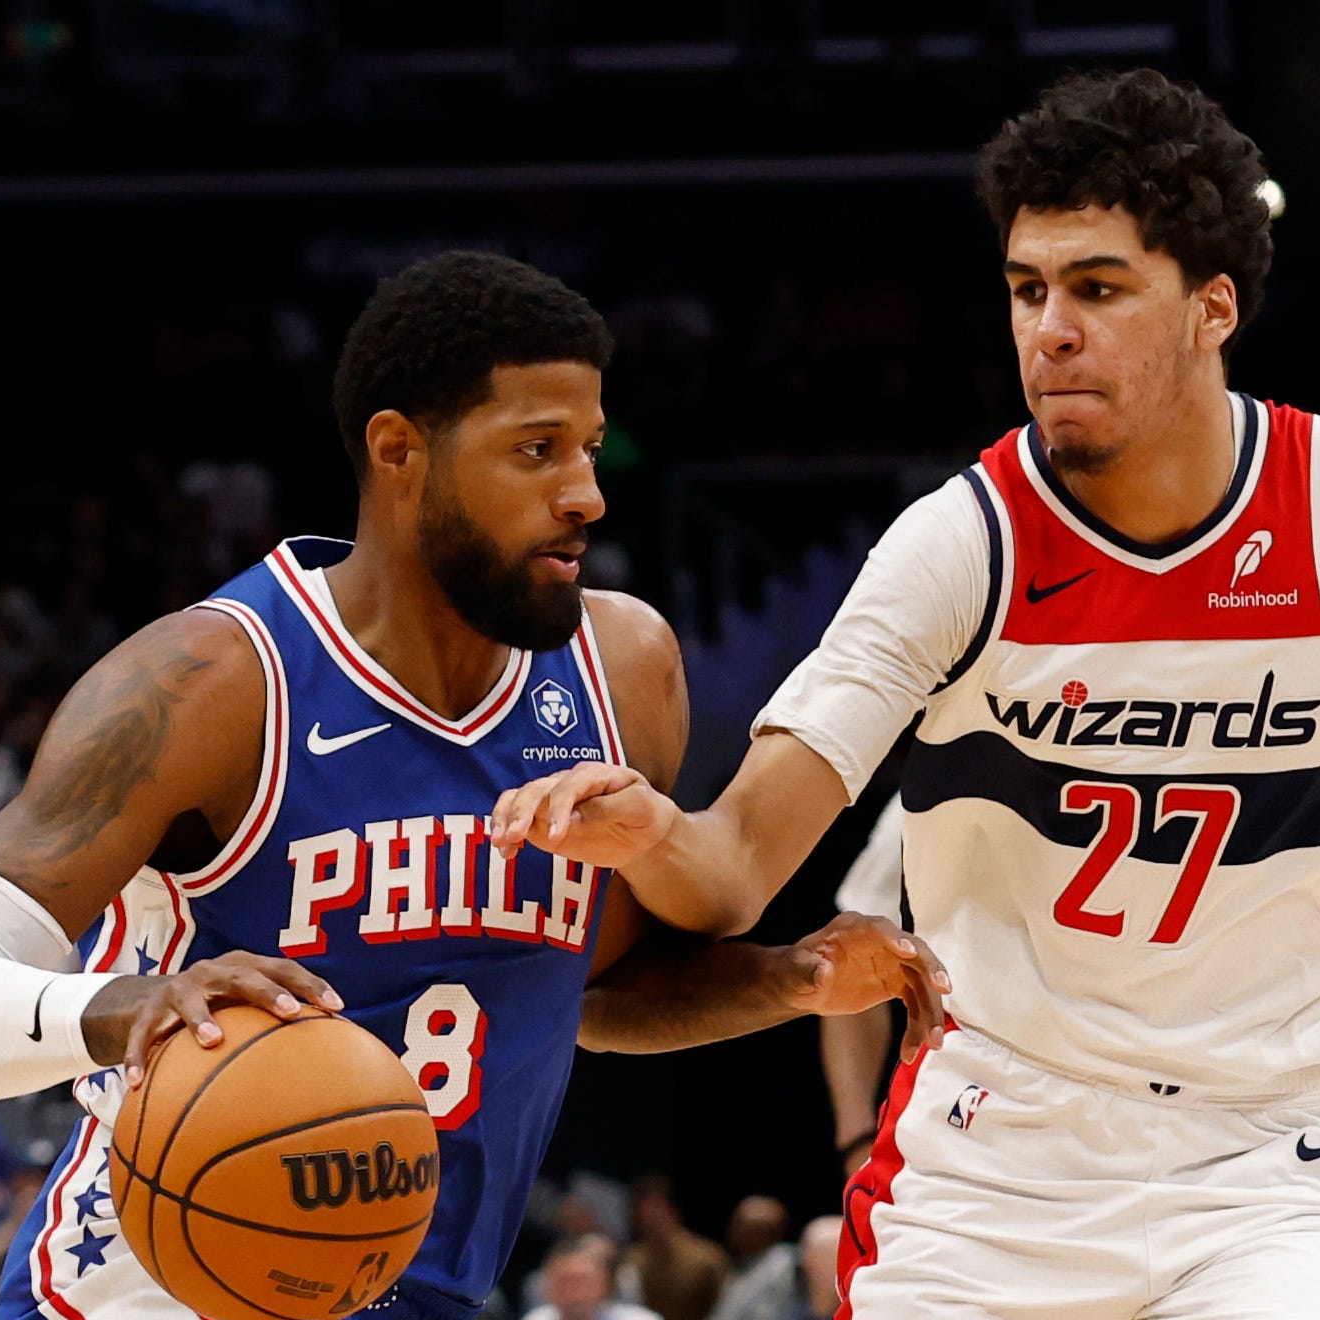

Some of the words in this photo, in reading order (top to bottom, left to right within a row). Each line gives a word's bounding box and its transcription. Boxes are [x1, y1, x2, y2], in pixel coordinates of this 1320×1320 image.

[1207, 587, 1299, 609] Robinhood
[522, 744, 602, 762] crypto.com
[1052, 781, 1242, 945] 27
[400, 983, 489, 1131] 8
